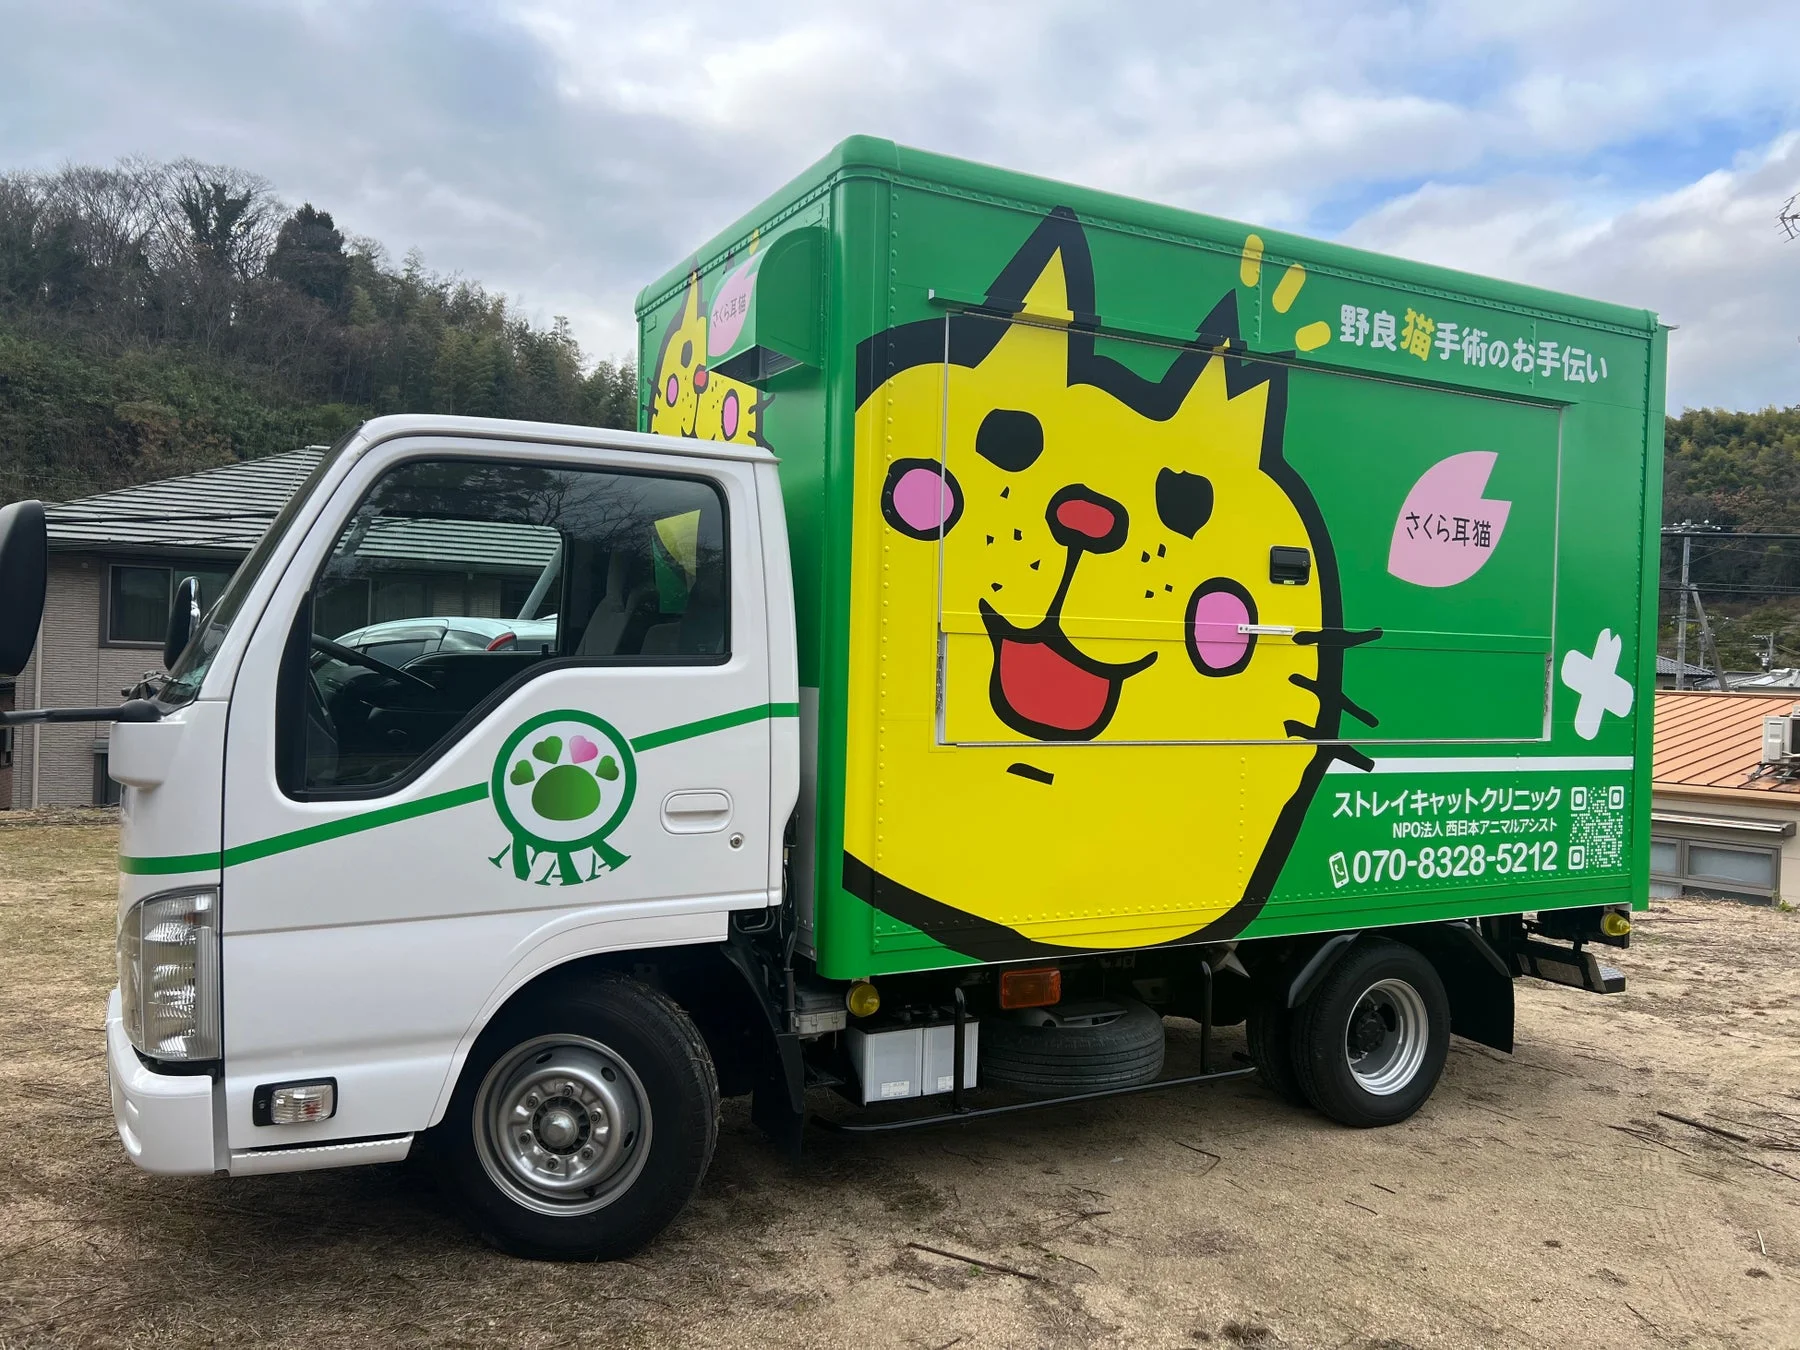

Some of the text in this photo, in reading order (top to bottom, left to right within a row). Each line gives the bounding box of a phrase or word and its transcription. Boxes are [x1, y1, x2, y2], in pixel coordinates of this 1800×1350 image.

[1340, 304, 1608, 383] 野良猫手術のお手伝い
[1405, 512, 1492, 547] さくら耳猫
[1332, 786, 1561, 818] ストレイキャットクリニック
[1392, 817, 1558, 839] NPO法人 西日本アニマルアシスト
[1352, 841, 1558, 883] 070-8328-5212
